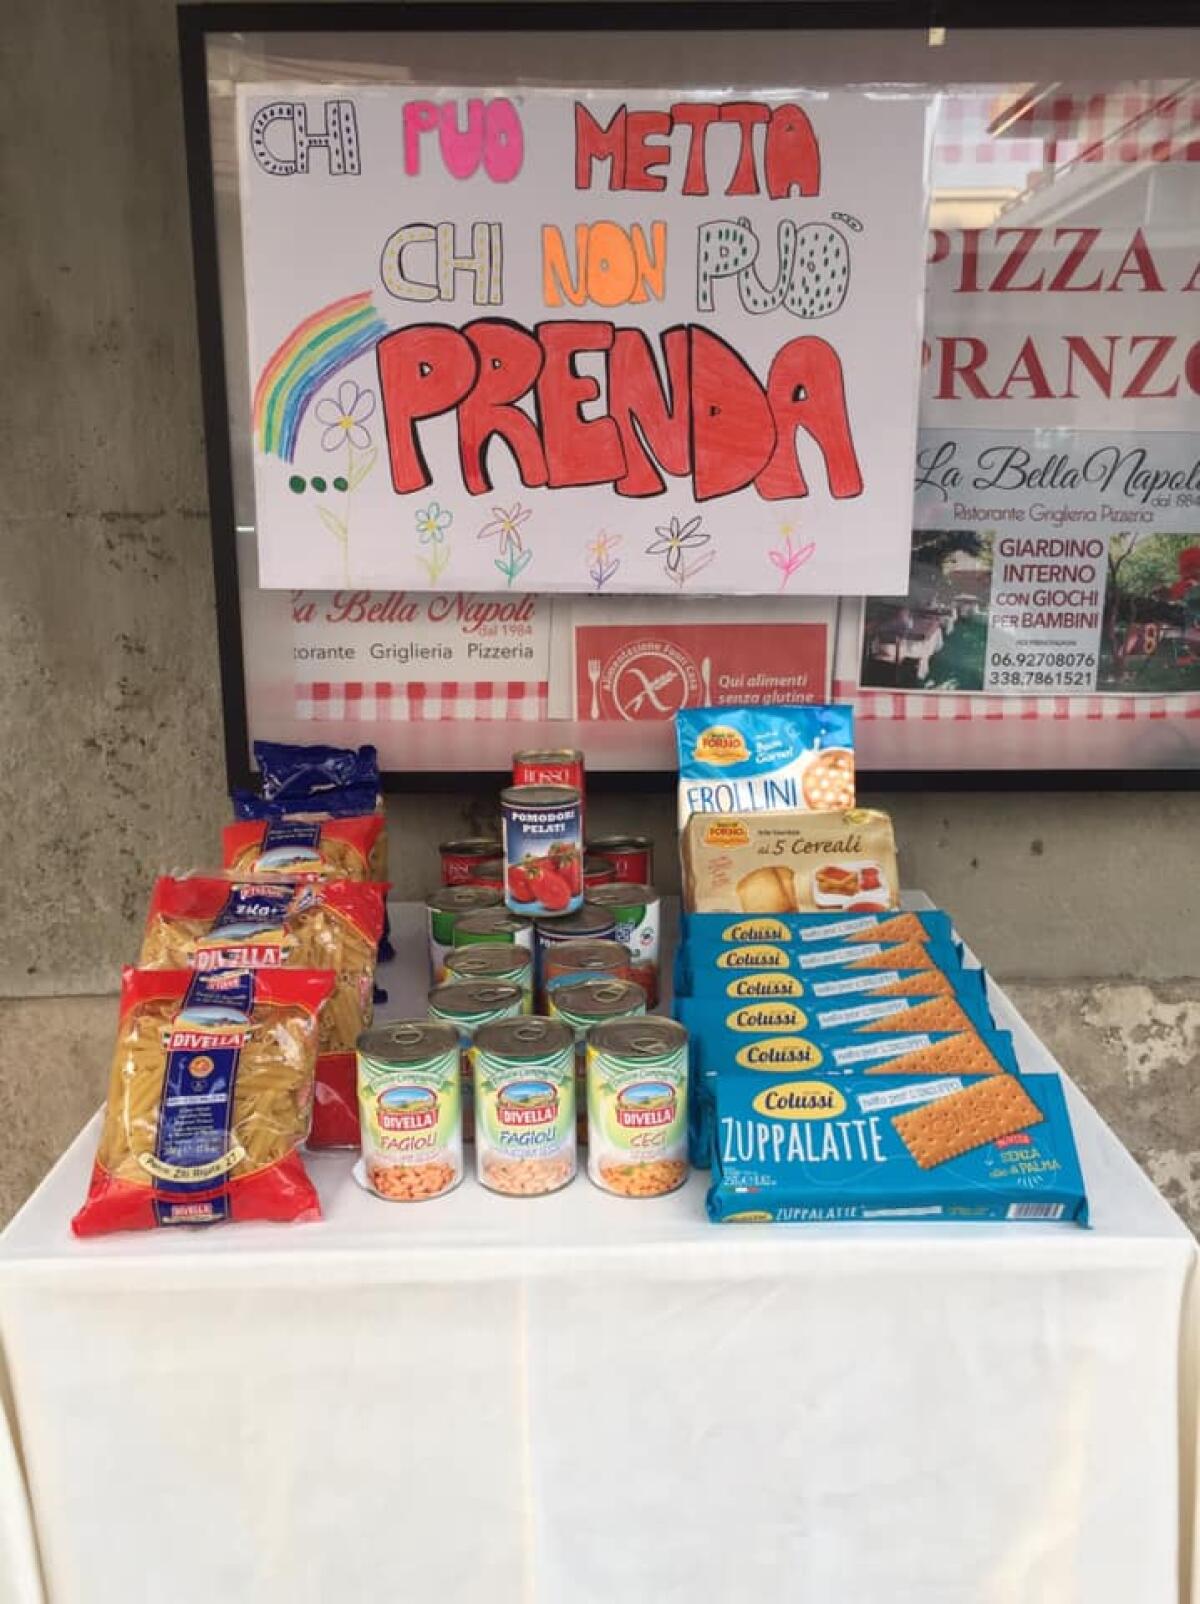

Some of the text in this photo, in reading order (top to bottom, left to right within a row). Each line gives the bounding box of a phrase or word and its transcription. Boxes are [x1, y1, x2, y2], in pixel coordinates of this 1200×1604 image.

[251, 101, 361, 175] CHI
[575, 101, 821, 199] METTA
[381, 222, 503, 305] CHI
[542, 220, 667, 307] NON
[922, 335, 1200, 400] RANZ
[376, 317, 863, 499] PRENDA
[915, 441, 963, 502] La
[973, 446, 1080, 490] Bella
[953, 503, 1025, 521] Ristorante
[1000, 538, 1103, 558] GIARDINO
[1003, 564, 1095, 583] INTERNO
[997, 590, 1098, 606] CON GIOCHI
[326, 590, 419, 622] Bella
[427, 592, 536, 633] Napoli
[1022, 613, 1098, 628] BAMBINI
[370, 643, 453, 663] Griglieria
[467, 643, 534, 660] Pizzeria
[991, 652, 1096, 668] 06.92708076
[719, 674, 807, 688] Qui alimenti
[990, 671, 1092, 686] 338.7861521
[718, 691, 814, 706] senza glutine
[687, 778, 797, 813] FROLLINI
[512, 809, 575, 823] POMODORI
[522, 822, 566, 833] PELATI
[773, 839, 787, 855] 5
[791, 834, 862, 855] Cereali
[731, 923, 783, 941] Colussi
[726, 950, 780, 967] Colussi
[736, 979, 794, 996] Colussi
[736, 1011, 797, 1027] Colussi
[174, 1032, 241, 1048] DIVELLA
[748, 1045, 811, 1063] Colussi
[764, 1091, 835, 1110] Colussi
[383, 1113, 433, 1129] DIVELLA
[504, 1108, 553, 1123] DIVELLA
[623, 1109, 672, 1125] DIVELLA
[380, 1131, 437, 1151] FAGIOLI
[501, 1127, 556, 1145] FAGIOLI
[721, 1116, 887, 1163] ZUPPALATTE
